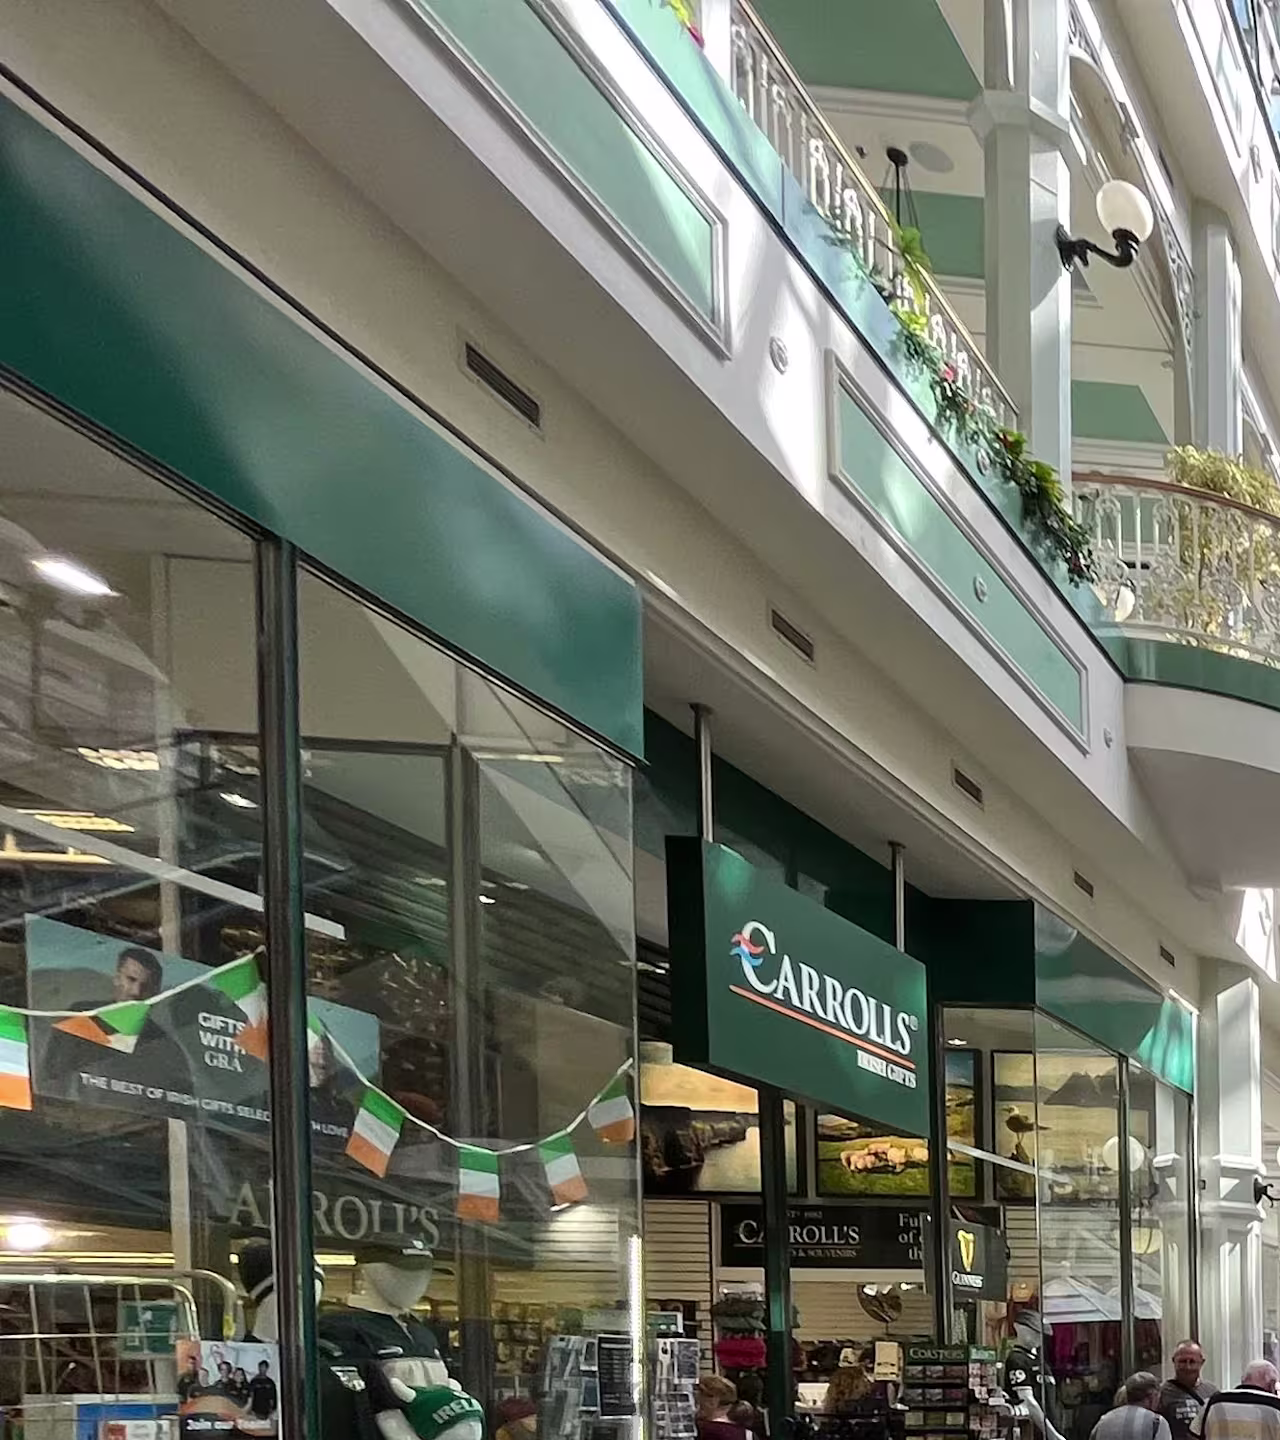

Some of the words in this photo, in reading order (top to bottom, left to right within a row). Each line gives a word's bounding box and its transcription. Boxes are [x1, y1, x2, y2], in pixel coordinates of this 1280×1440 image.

[735, 920, 911, 1056] CARROLLS
[198, 1012, 246, 1034] GIFTS
[887, 1064, 916, 1088] GIFTS
[80, 1072, 107, 1090] THE
[111, 1077, 144, 1098] BEST
[146, 1086, 163, 1099] OF
[202, 1098, 235, 1115] GIFTS
[237, 1104, 271, 1122] SELEC
